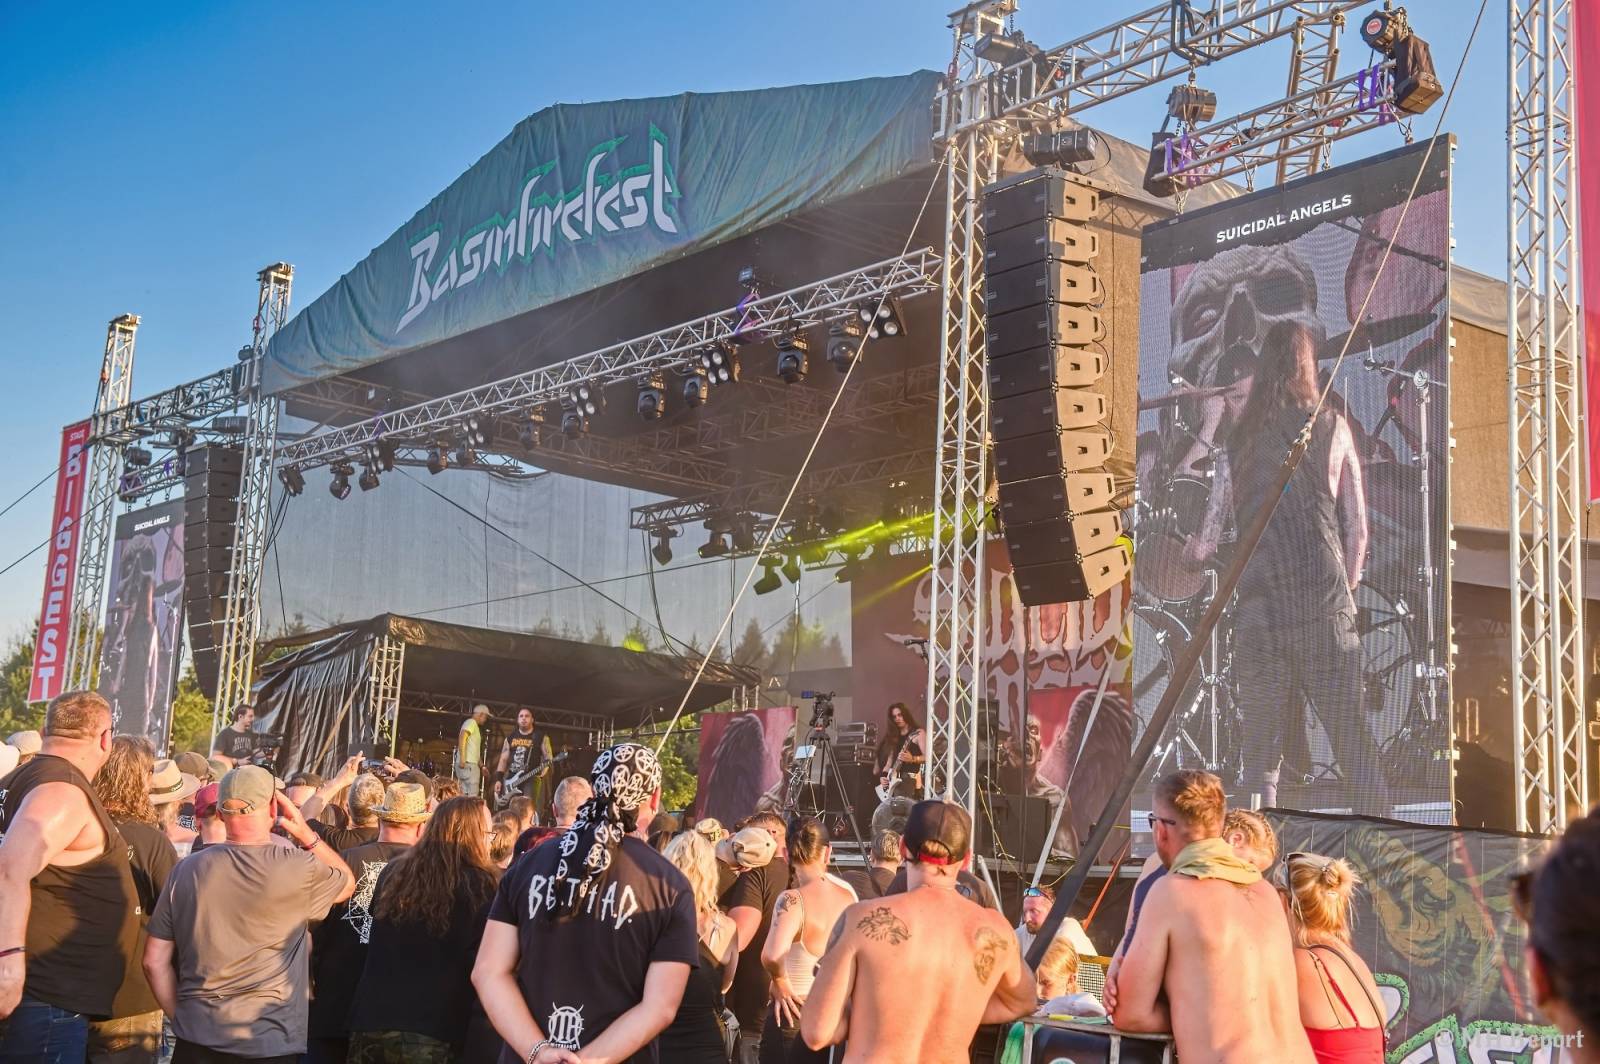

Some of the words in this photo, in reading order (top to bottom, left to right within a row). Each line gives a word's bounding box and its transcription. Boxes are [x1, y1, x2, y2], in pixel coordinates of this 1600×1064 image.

[1216, 214, 1286, 243] SUICIDAL
[1289, 195, 1352, 222] ANGELS
[38, 444, 83, 701] BIGGEST
